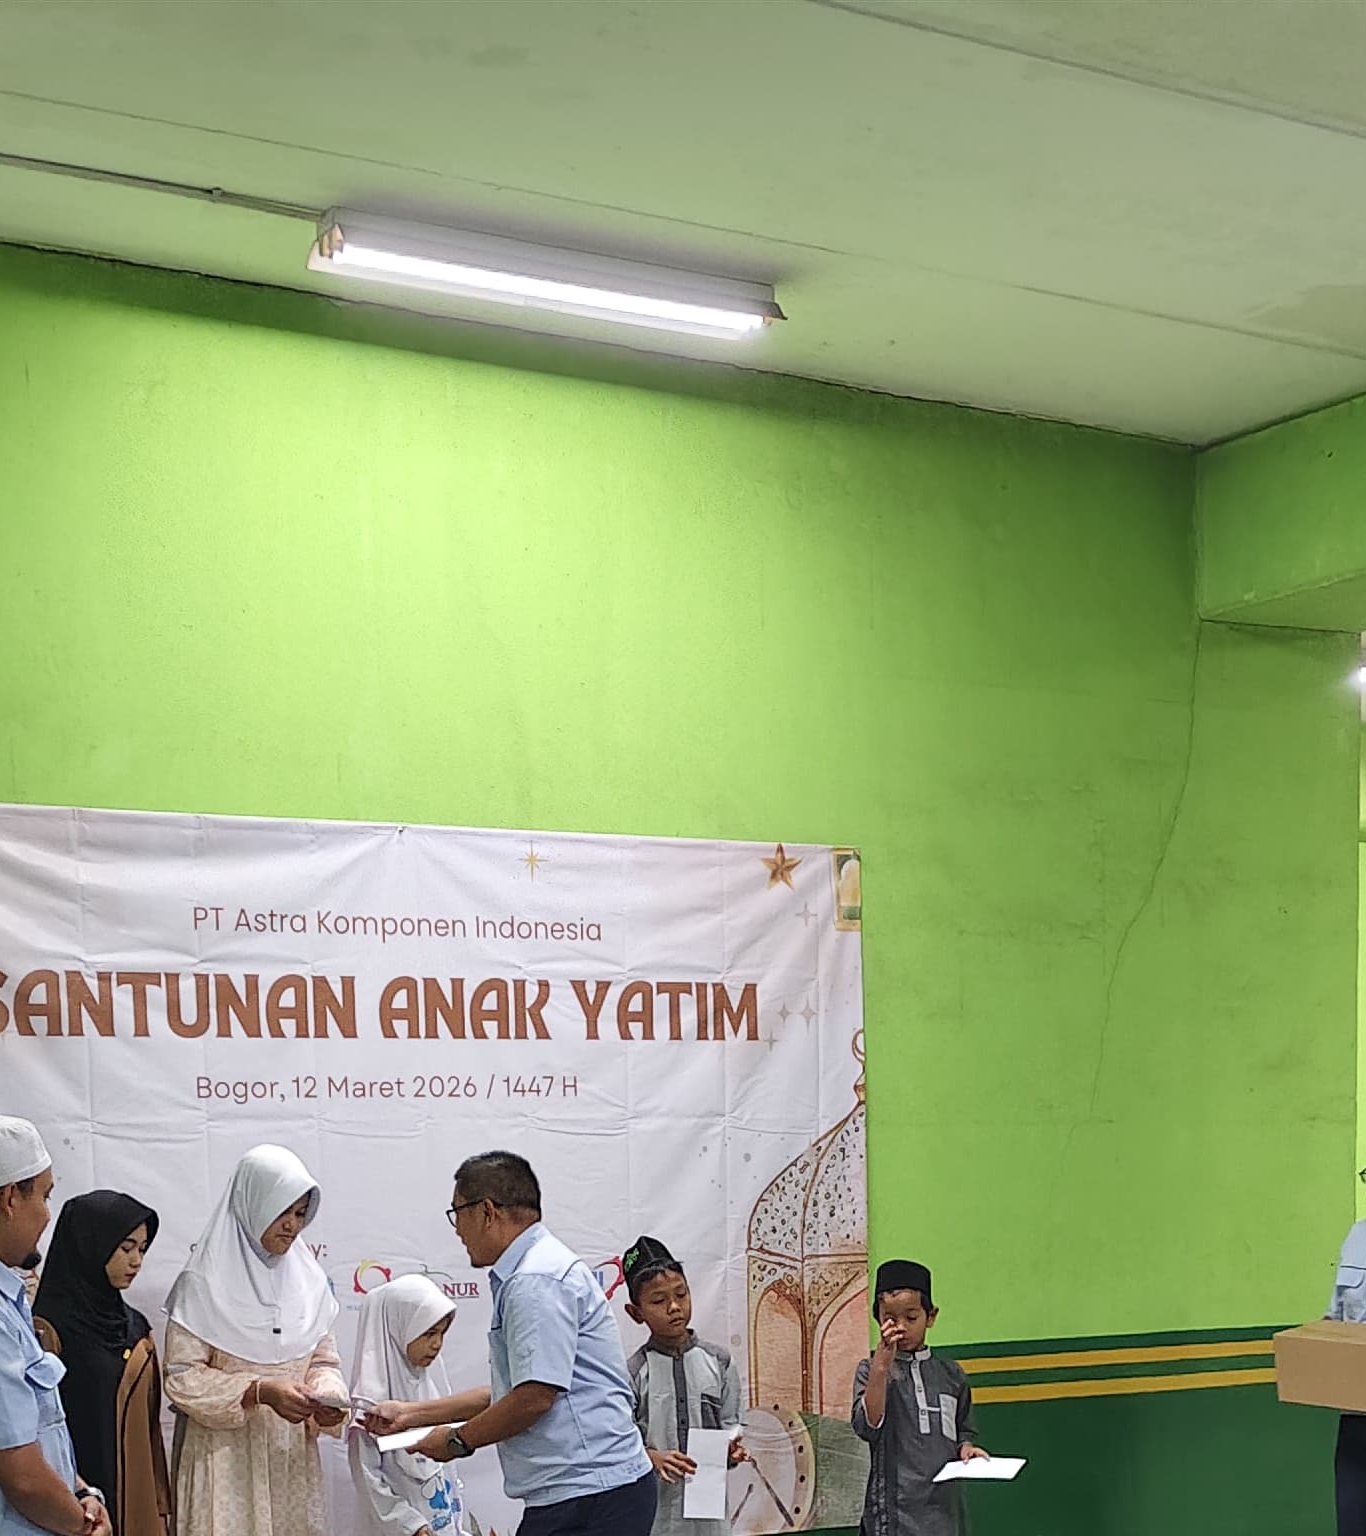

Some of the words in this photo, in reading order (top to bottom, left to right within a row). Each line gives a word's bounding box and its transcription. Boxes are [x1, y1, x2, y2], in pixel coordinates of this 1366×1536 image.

[193, 907, 224, 931] PT
[235, 909, 307, 935] Astra
[317, 911, 466, 944] Komponen
[476, 916, 602, 942] Indonesia
[378, 976, 553, 1041] ANAK
[569, 980, 759, 1042] YATIM
[196, 1076, 285, 1103] Bogor,
[292, 1075, 317, 1099] 12
[328, 1076, 403, 1099] Maret
[413, 1075, 477, 1098] 2026
[486, 1074, 496, 1099] /
[503, 1075, 555, 1098] 1447
[563, 1075, 578, 1098] H
